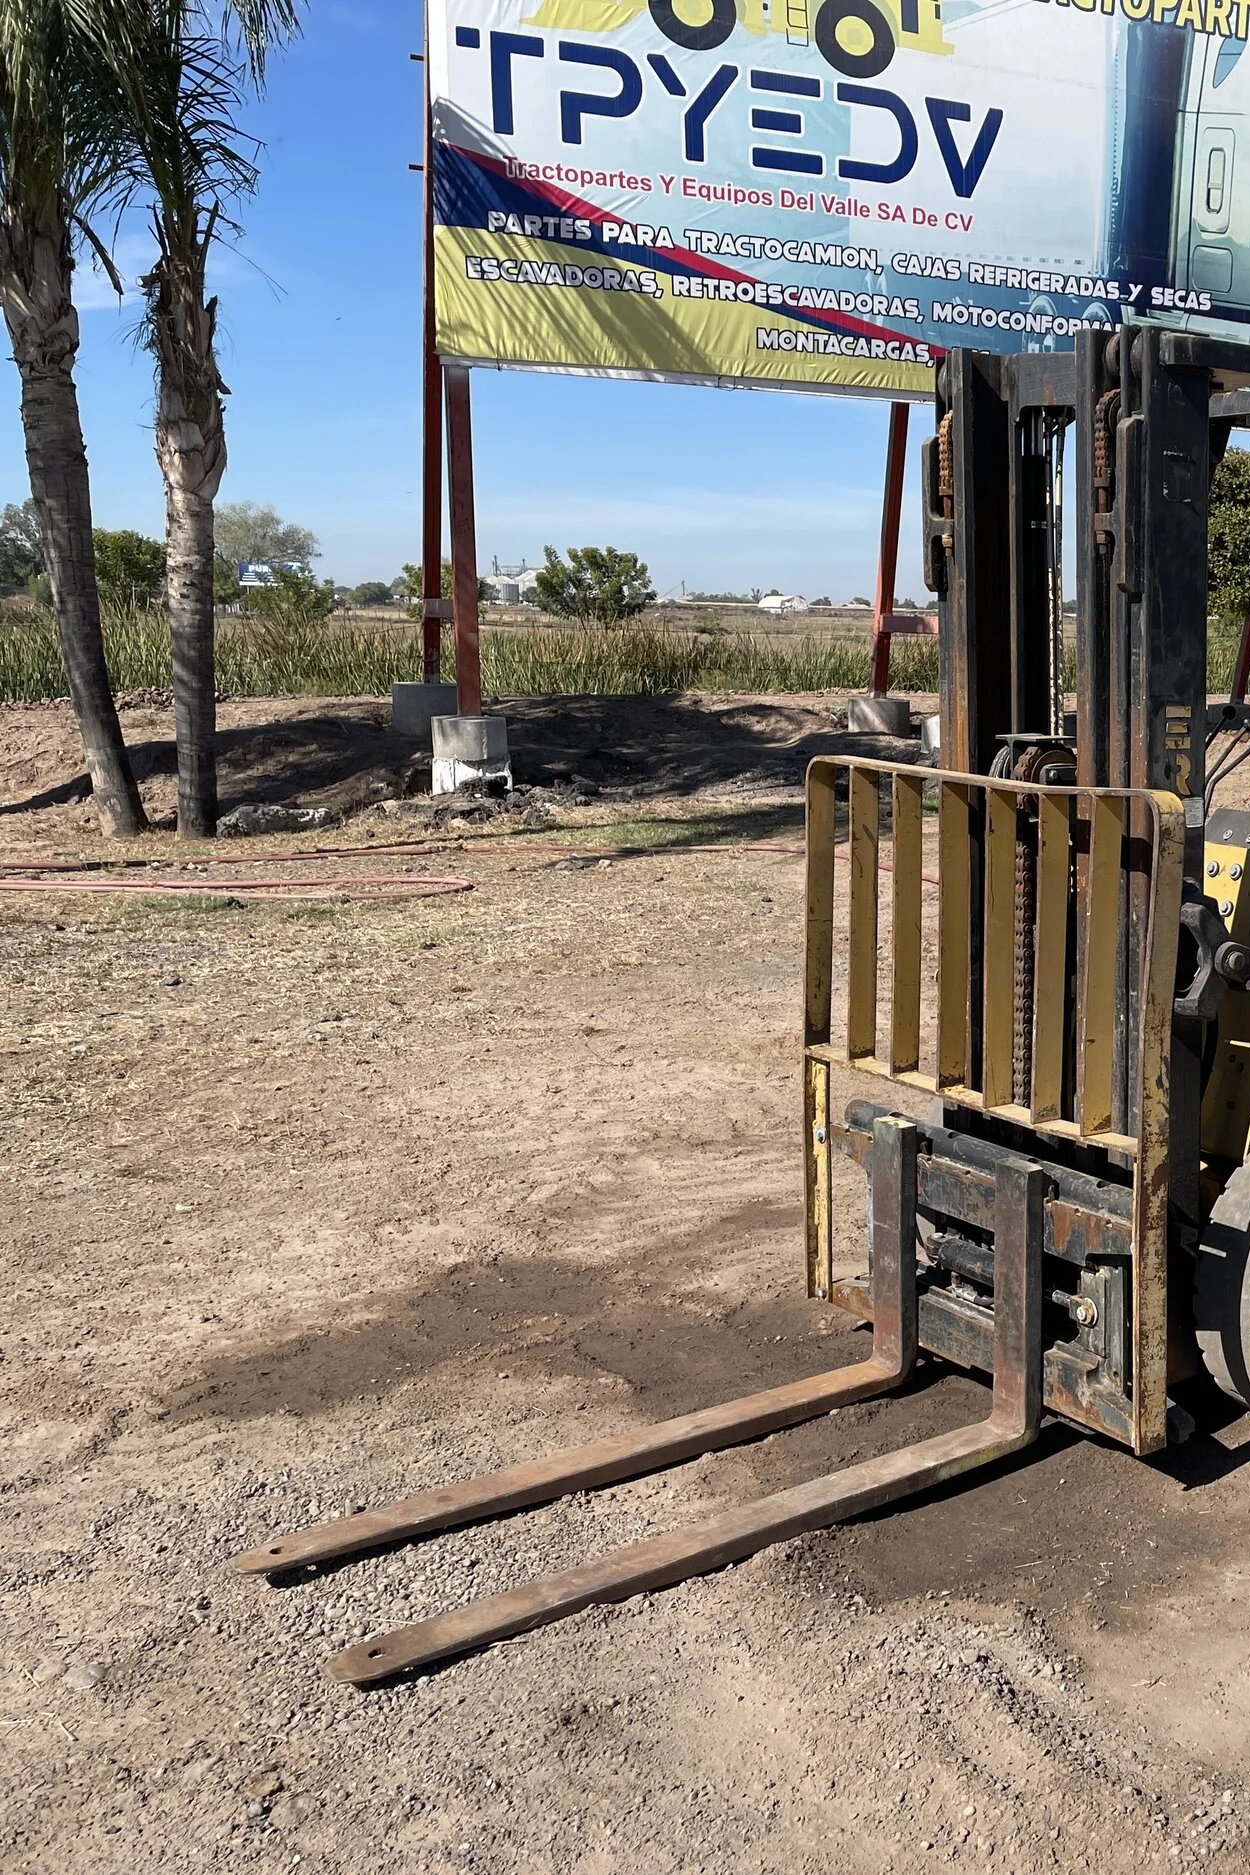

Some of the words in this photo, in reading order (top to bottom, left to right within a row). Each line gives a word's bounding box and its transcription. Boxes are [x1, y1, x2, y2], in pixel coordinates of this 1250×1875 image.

[455, 27, 1004, 199] TPYEDV
[503, 155, 652, 192] Tractopartes
[659, 174, 676, 195] Y
[682, 178, 773, 206] Equipos
[780, 189, 814, 212] Del
[821, 194, 871, 218] Valle
[877, 202, 907, 223] SA
[912, 207, 938, 228] De
[944, 212, 974, 232] CV
[466, 256, 664, 299] ESCAVADORAS,
[672, 275, 925, 324] RETROESCAVADORAS,
[487, 211, 592, 241] PARTES
[602, 220, 675, 250] PARA
[683, 229, 884, 275] TRACTOCAMION,
[891, 252, 961, 281] CAJAS
[968, 262, 1121, 301] REFRIGERADAS
[1127, 282, 1144, 303] Y
[1150, 286, 1212, 311] SECAS
[756, 328, 935, 368] MONTACARGAS,
